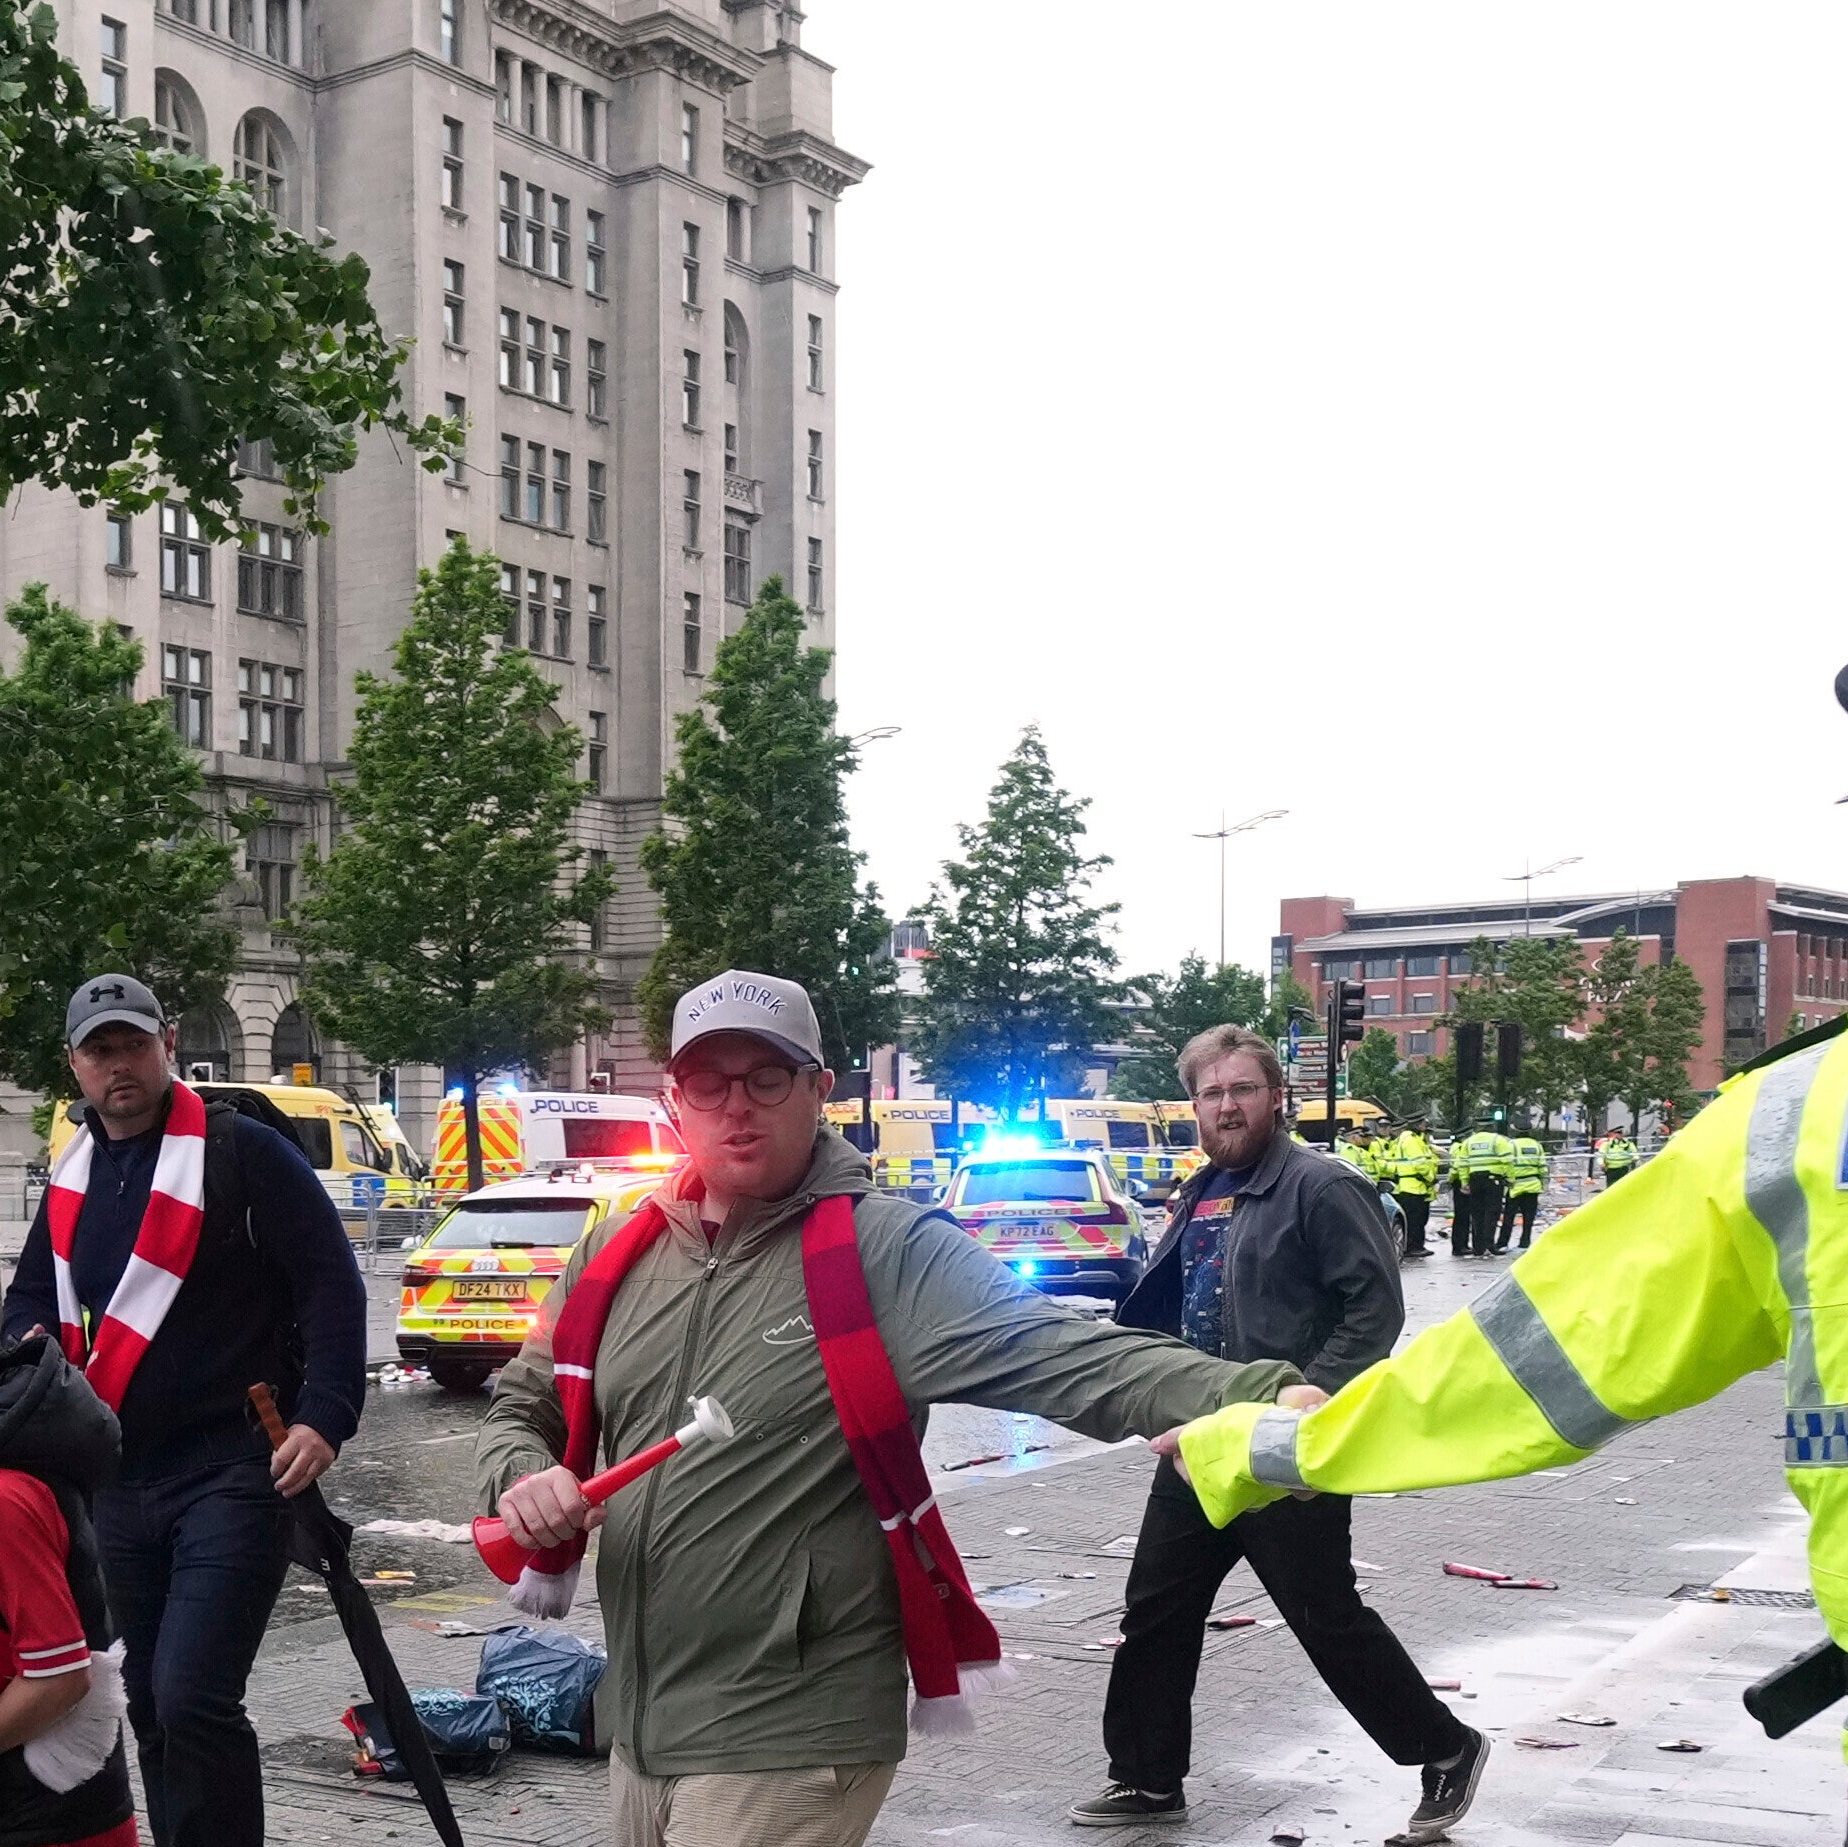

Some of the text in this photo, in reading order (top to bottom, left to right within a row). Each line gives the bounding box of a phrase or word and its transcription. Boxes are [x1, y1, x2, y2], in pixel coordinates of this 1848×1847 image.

[687, 980, 787, 1022] NEW YORK
[535, 1100, 600, 1113] POLICE
[890, 1109, 950, 1119] POLICE
[1076, 1109, 1121, 1118] POLICE
[986, 1208, 1069, 1217] POLICE
[459, 1283, 521, 1296] DF24 TKX
[450, 1319, 515, 1330] POLICE
